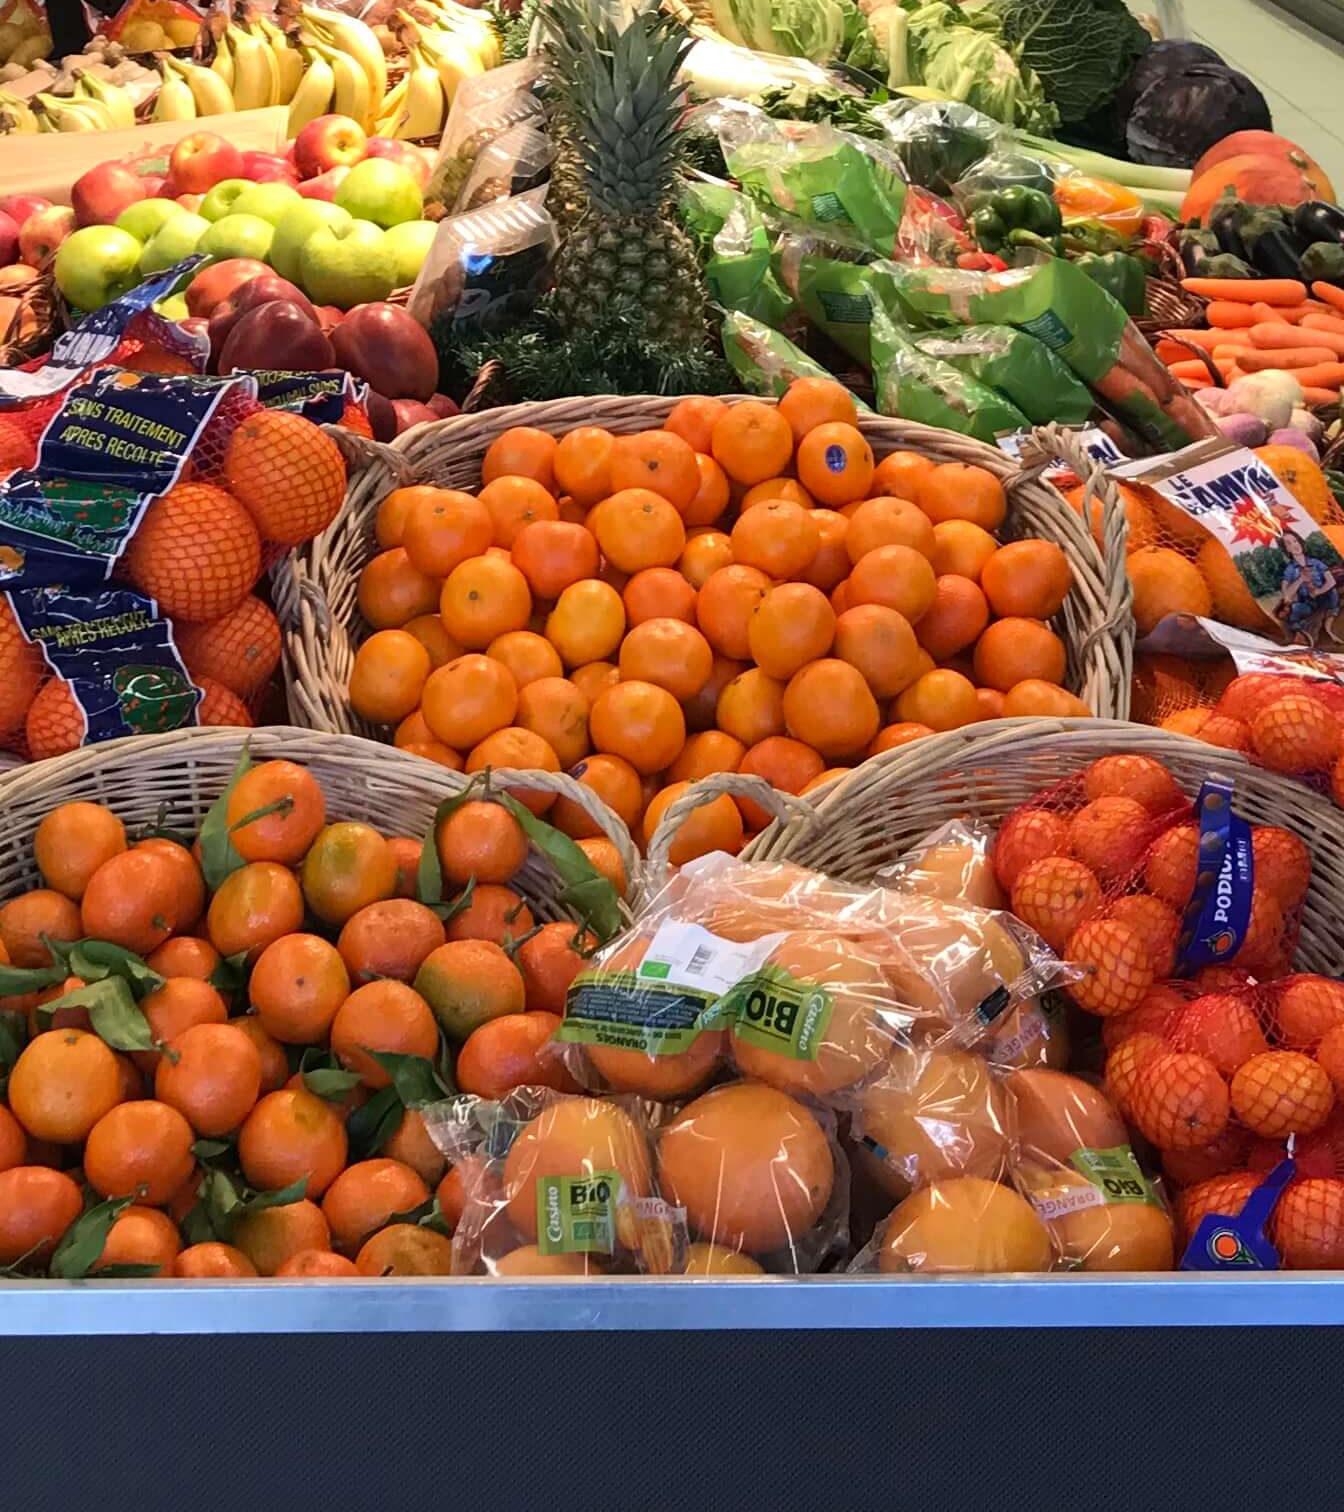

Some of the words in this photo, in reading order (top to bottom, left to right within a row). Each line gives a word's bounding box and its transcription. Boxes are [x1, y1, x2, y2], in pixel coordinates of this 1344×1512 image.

[59, 425, 105, 451] APRES
[106, 438, 167, 468] RECOLTE
[68, 397, 102, 418] SANS
[104, 404, 186, 449] TRAITEMENT
[1168, 474, 1194, 491] LE
[1214, 841, 1234, 923] PODIU
[595, 1031, 647, 1051] ORANGES
[799, 992, 824, 1051] Casino
[547, 1186, 563, 1242] Casino
